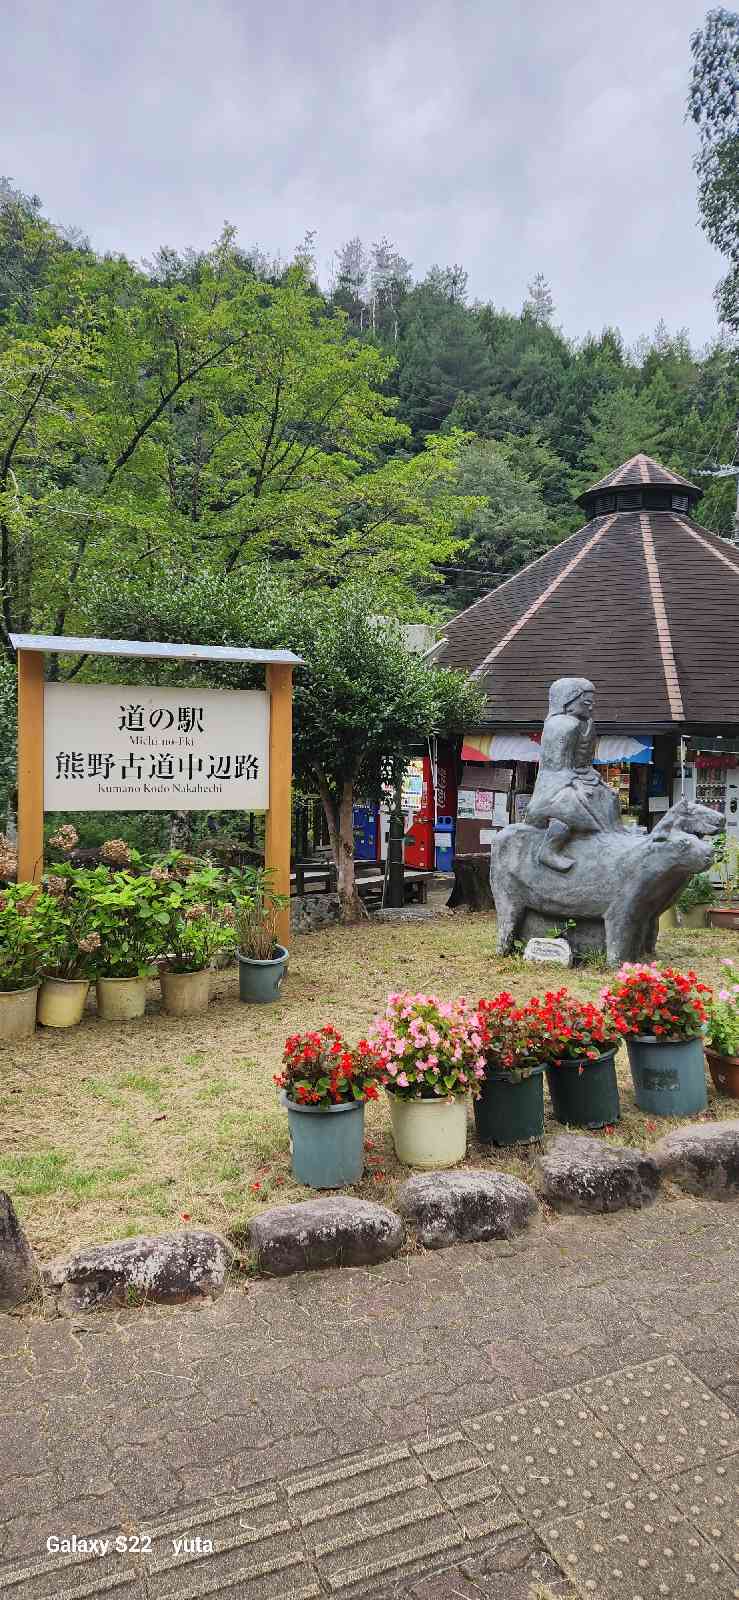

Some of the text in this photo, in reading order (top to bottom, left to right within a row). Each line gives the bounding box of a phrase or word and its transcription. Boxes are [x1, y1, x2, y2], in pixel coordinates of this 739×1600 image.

[118, 704, 204, 732] 道の駅
[55, 751, 259, 780] 熊野古道中辺路
